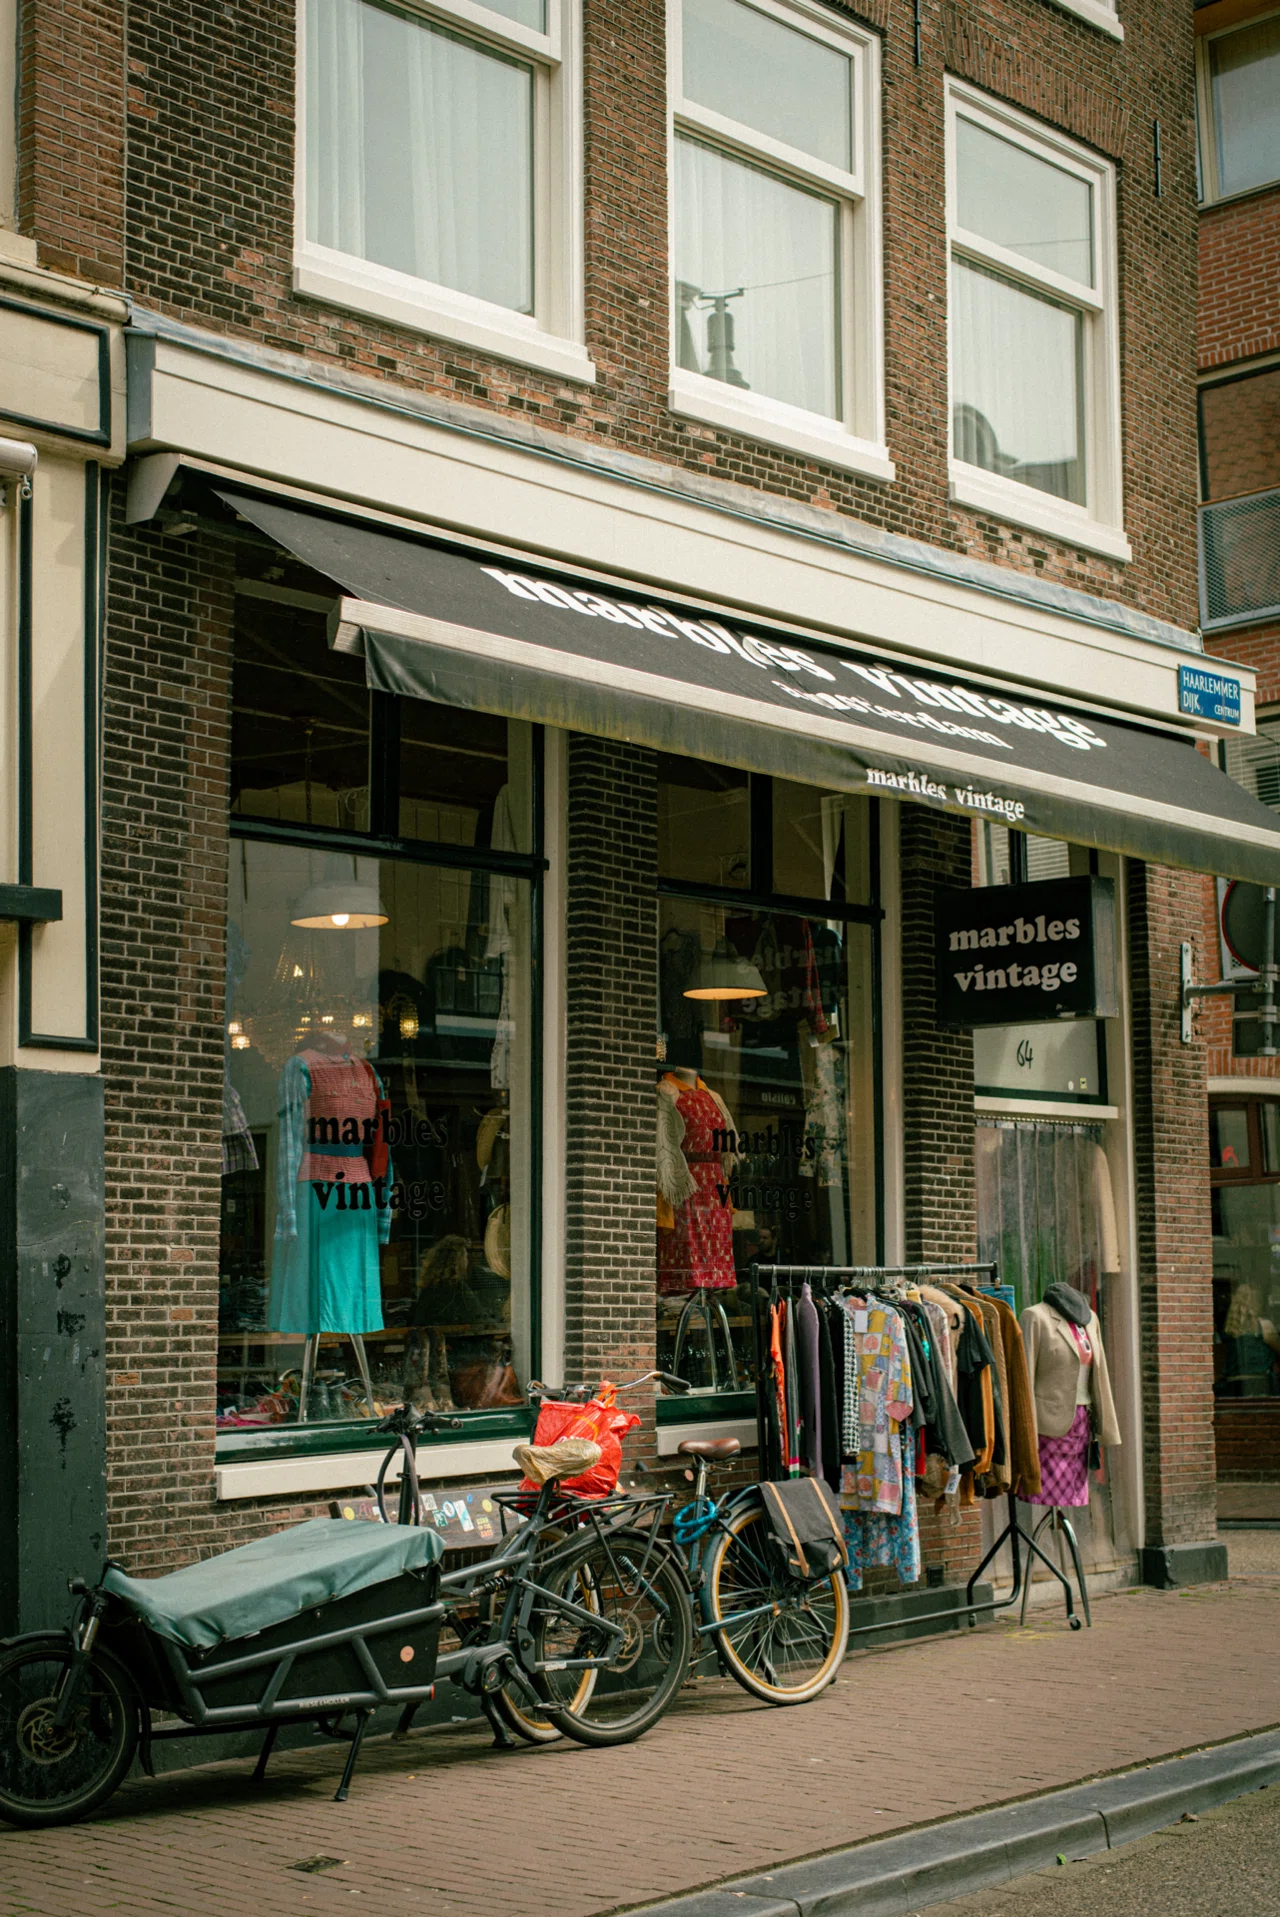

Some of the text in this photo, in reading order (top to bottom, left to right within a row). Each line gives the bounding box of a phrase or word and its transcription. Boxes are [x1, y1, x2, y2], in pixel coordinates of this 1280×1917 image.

[480, 567, 1107, 750] marbles vintage
[1182, 671, 1239, 700] HAARLEMMER
[1182, 691, 1240, 719] DIJK CENTRUM
[866, 767, 1025, 822] marbles vintage
[949, 915, 1081, 951] marbles
[953, 962, 1078, 992] vintage
[1016, 1040, 1034, 1069] 64
[306, 1107, 449, 1148] marbles
[712, 1124, 816, 1160] marbles
[312, 1170, 446, 1220] vintage
[716, 1175, 814, 1222] vintage
